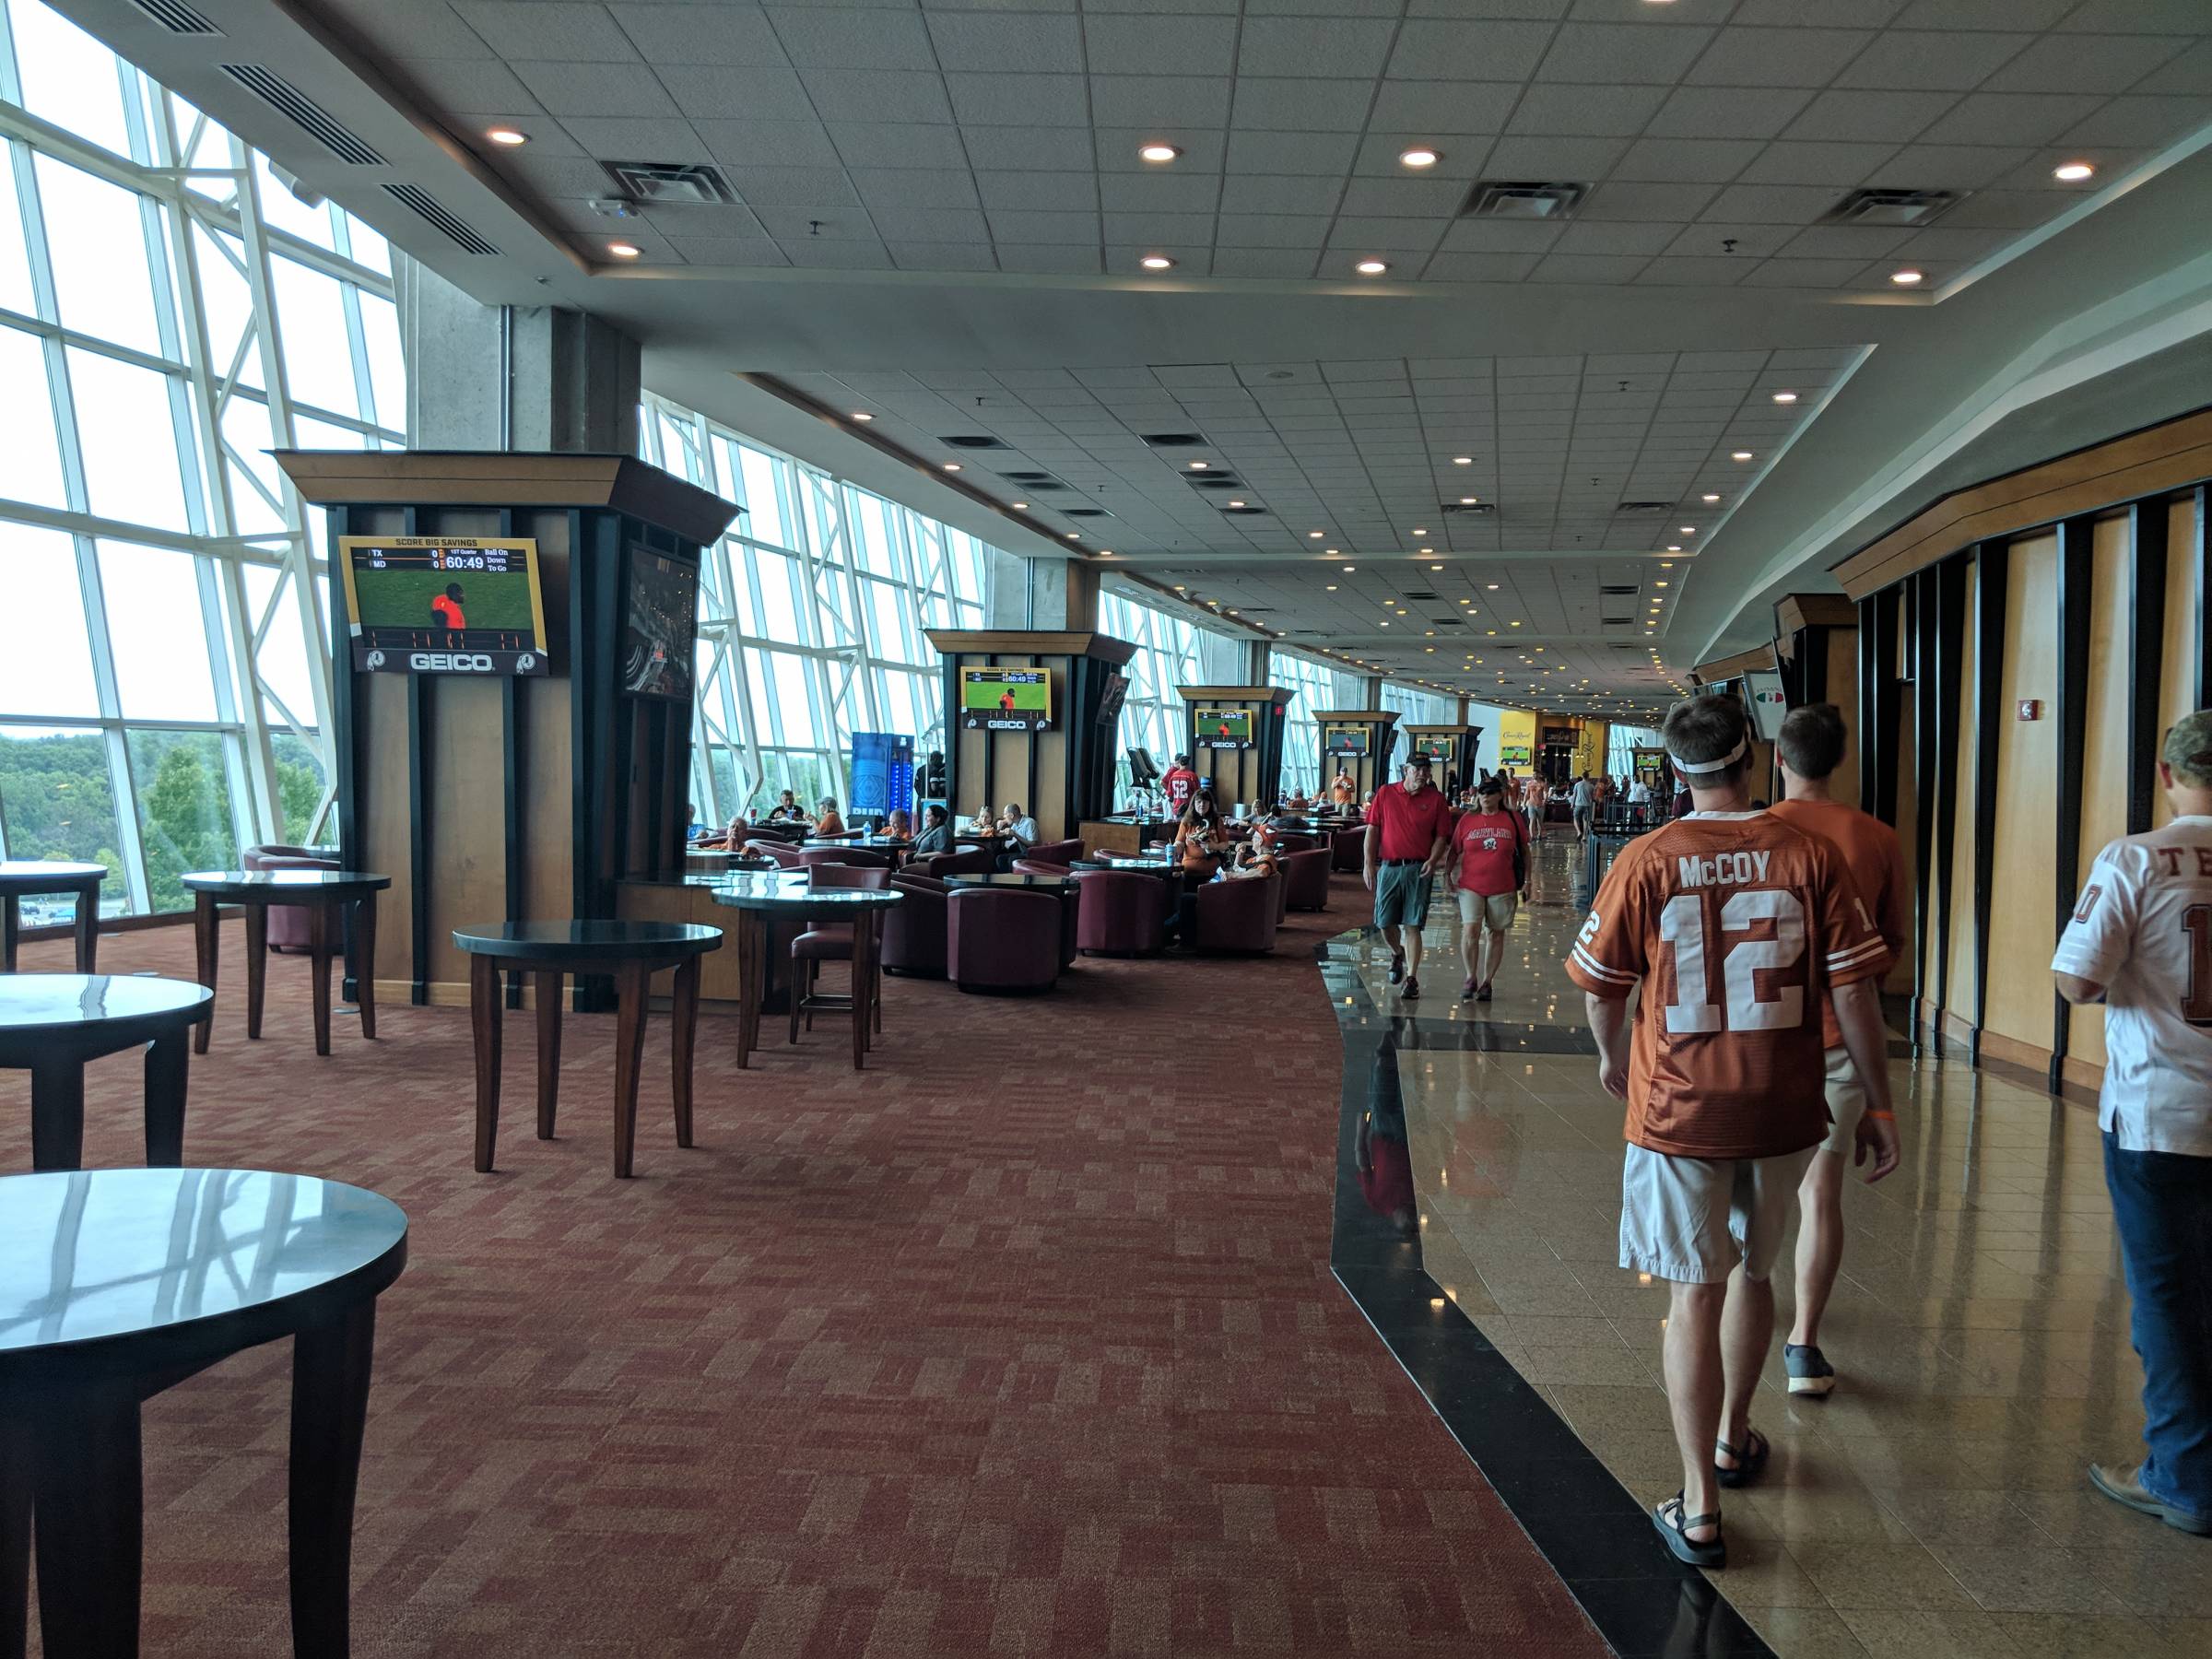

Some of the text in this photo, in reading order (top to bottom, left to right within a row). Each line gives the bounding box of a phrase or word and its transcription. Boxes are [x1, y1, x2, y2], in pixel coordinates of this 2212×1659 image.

[426, 538, 440, 547] BIG
[441, 539, 478, 547] SAVINGS
[431, 549, 438, 558] 0
[433, 560, 440, 569] 0
[446, 556, 484, 569] 60:49
[410, 653, 494, 671] GEICO
[987, 720, 1027, 729] GEICO
[1660, 889, 1806, 1033] 12
